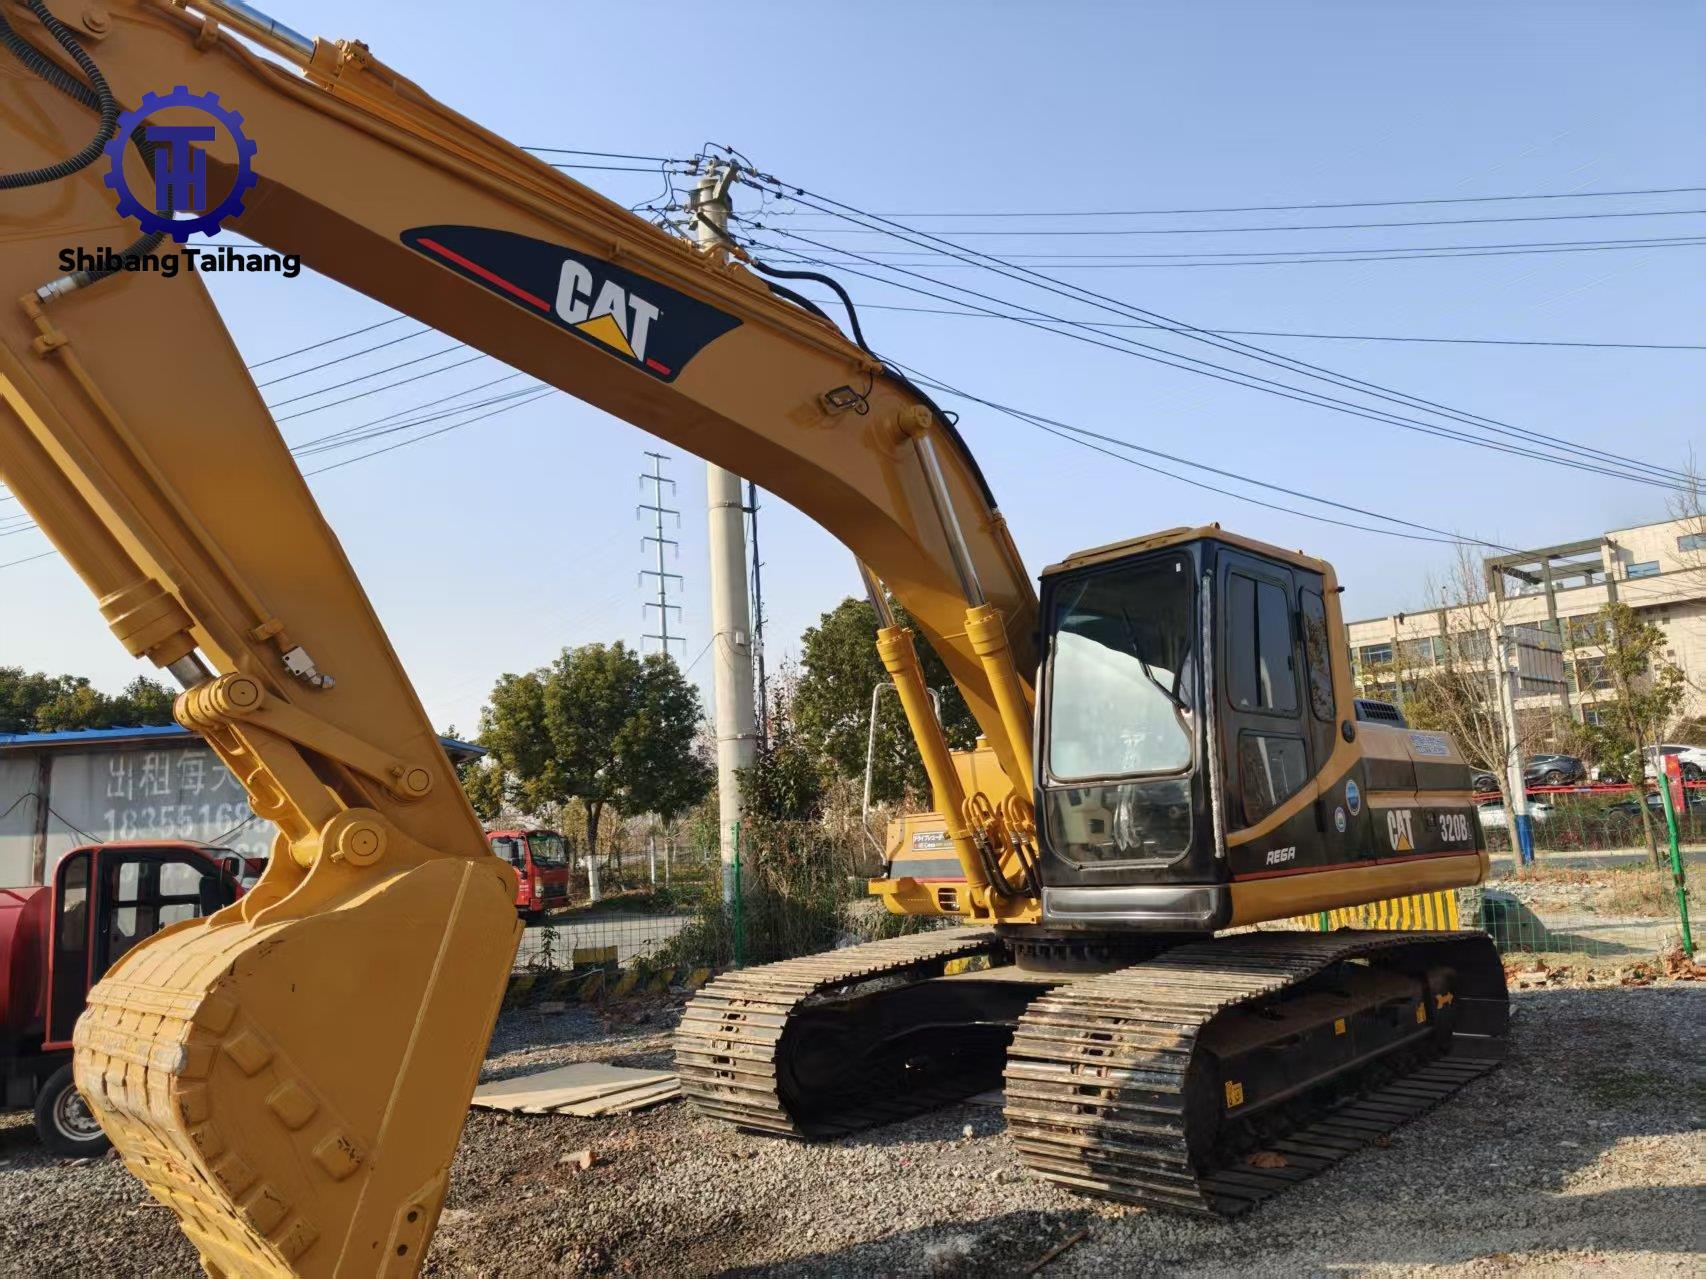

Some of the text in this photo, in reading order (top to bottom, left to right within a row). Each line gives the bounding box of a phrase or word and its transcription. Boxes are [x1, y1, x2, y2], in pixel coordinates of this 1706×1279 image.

[555, 259, 660, 362] CAT
[1386, 809, 1415, 850] CAT
[1439, 814, 1468, 842] 320B
